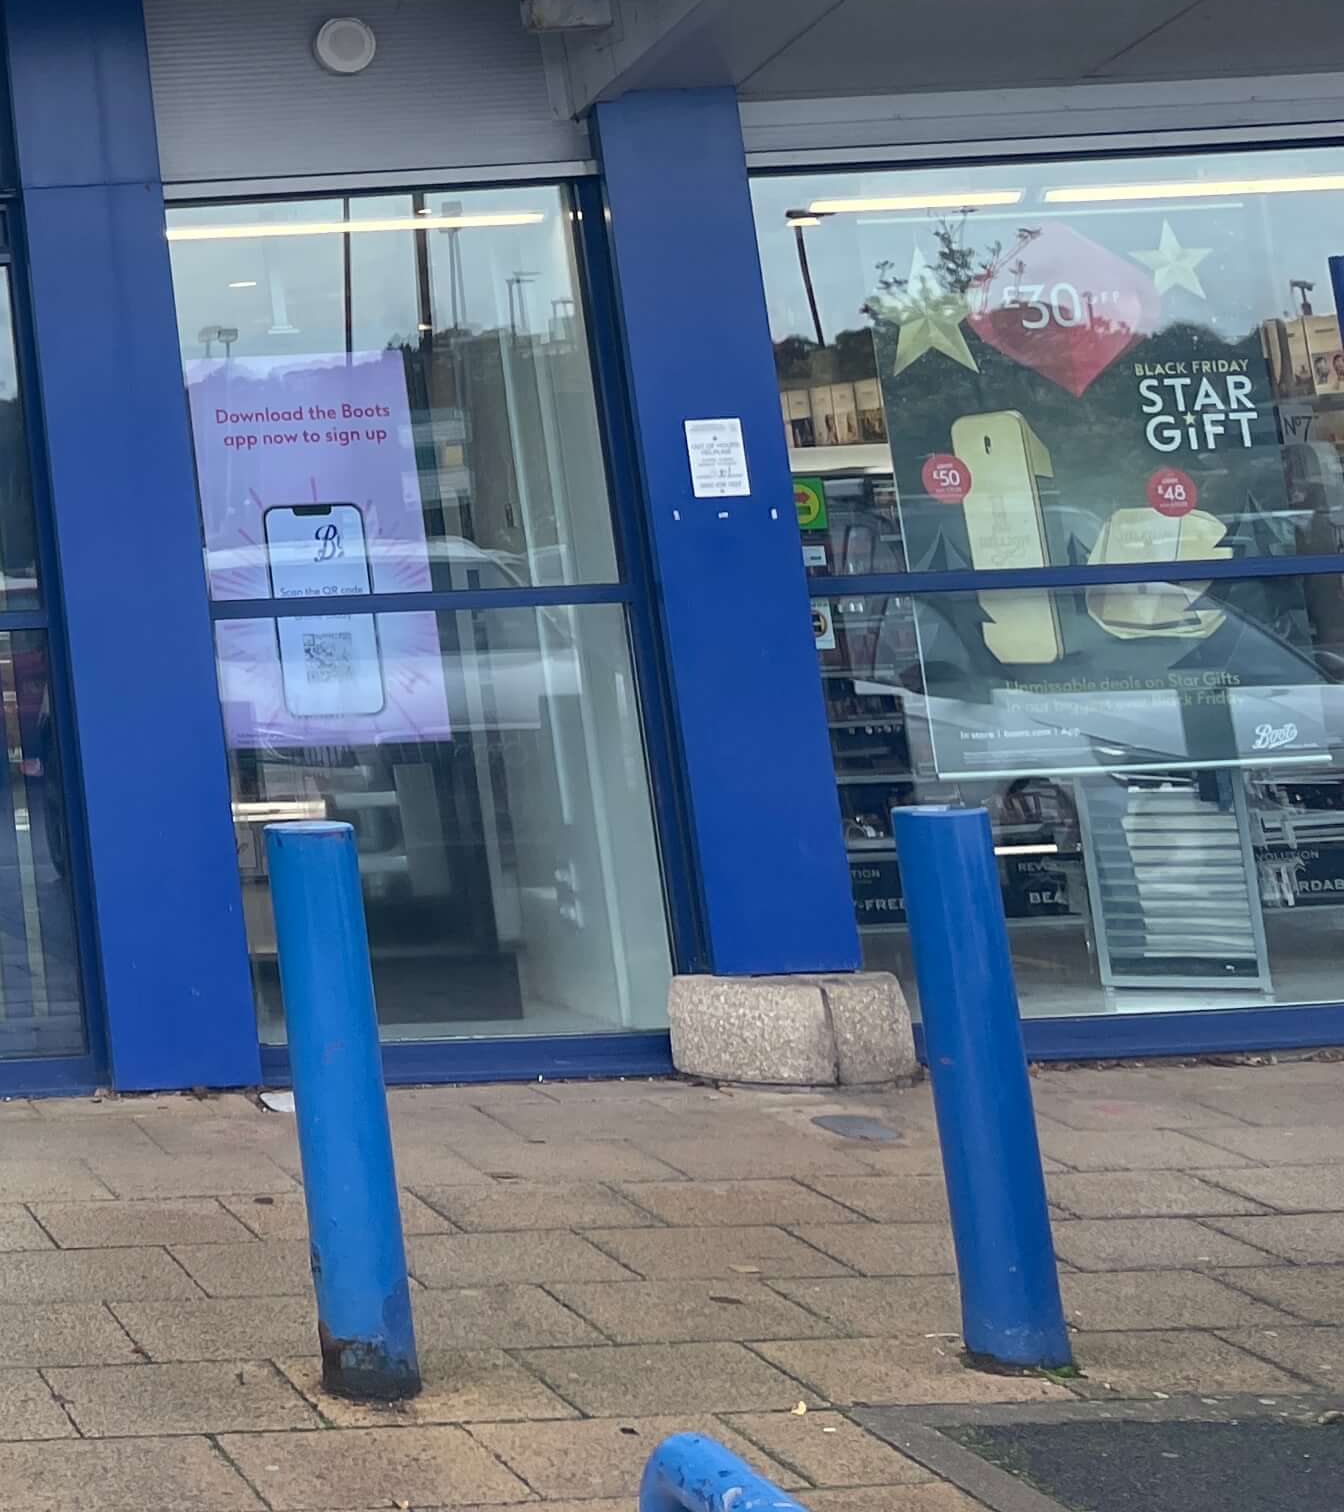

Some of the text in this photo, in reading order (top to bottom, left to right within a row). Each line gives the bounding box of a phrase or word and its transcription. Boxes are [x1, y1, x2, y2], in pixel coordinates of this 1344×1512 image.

[1135, 359, 1248, 376] BLACK FRIDAY
[1139, 375, 1256, 413] STAR
[215, 403, 390, 425] Download the Boots
[223, 427, 388, 451] app now to sign up
[1168, 673, 1200, 688] Star
[1202, 671, 1241, 687] Gifts
